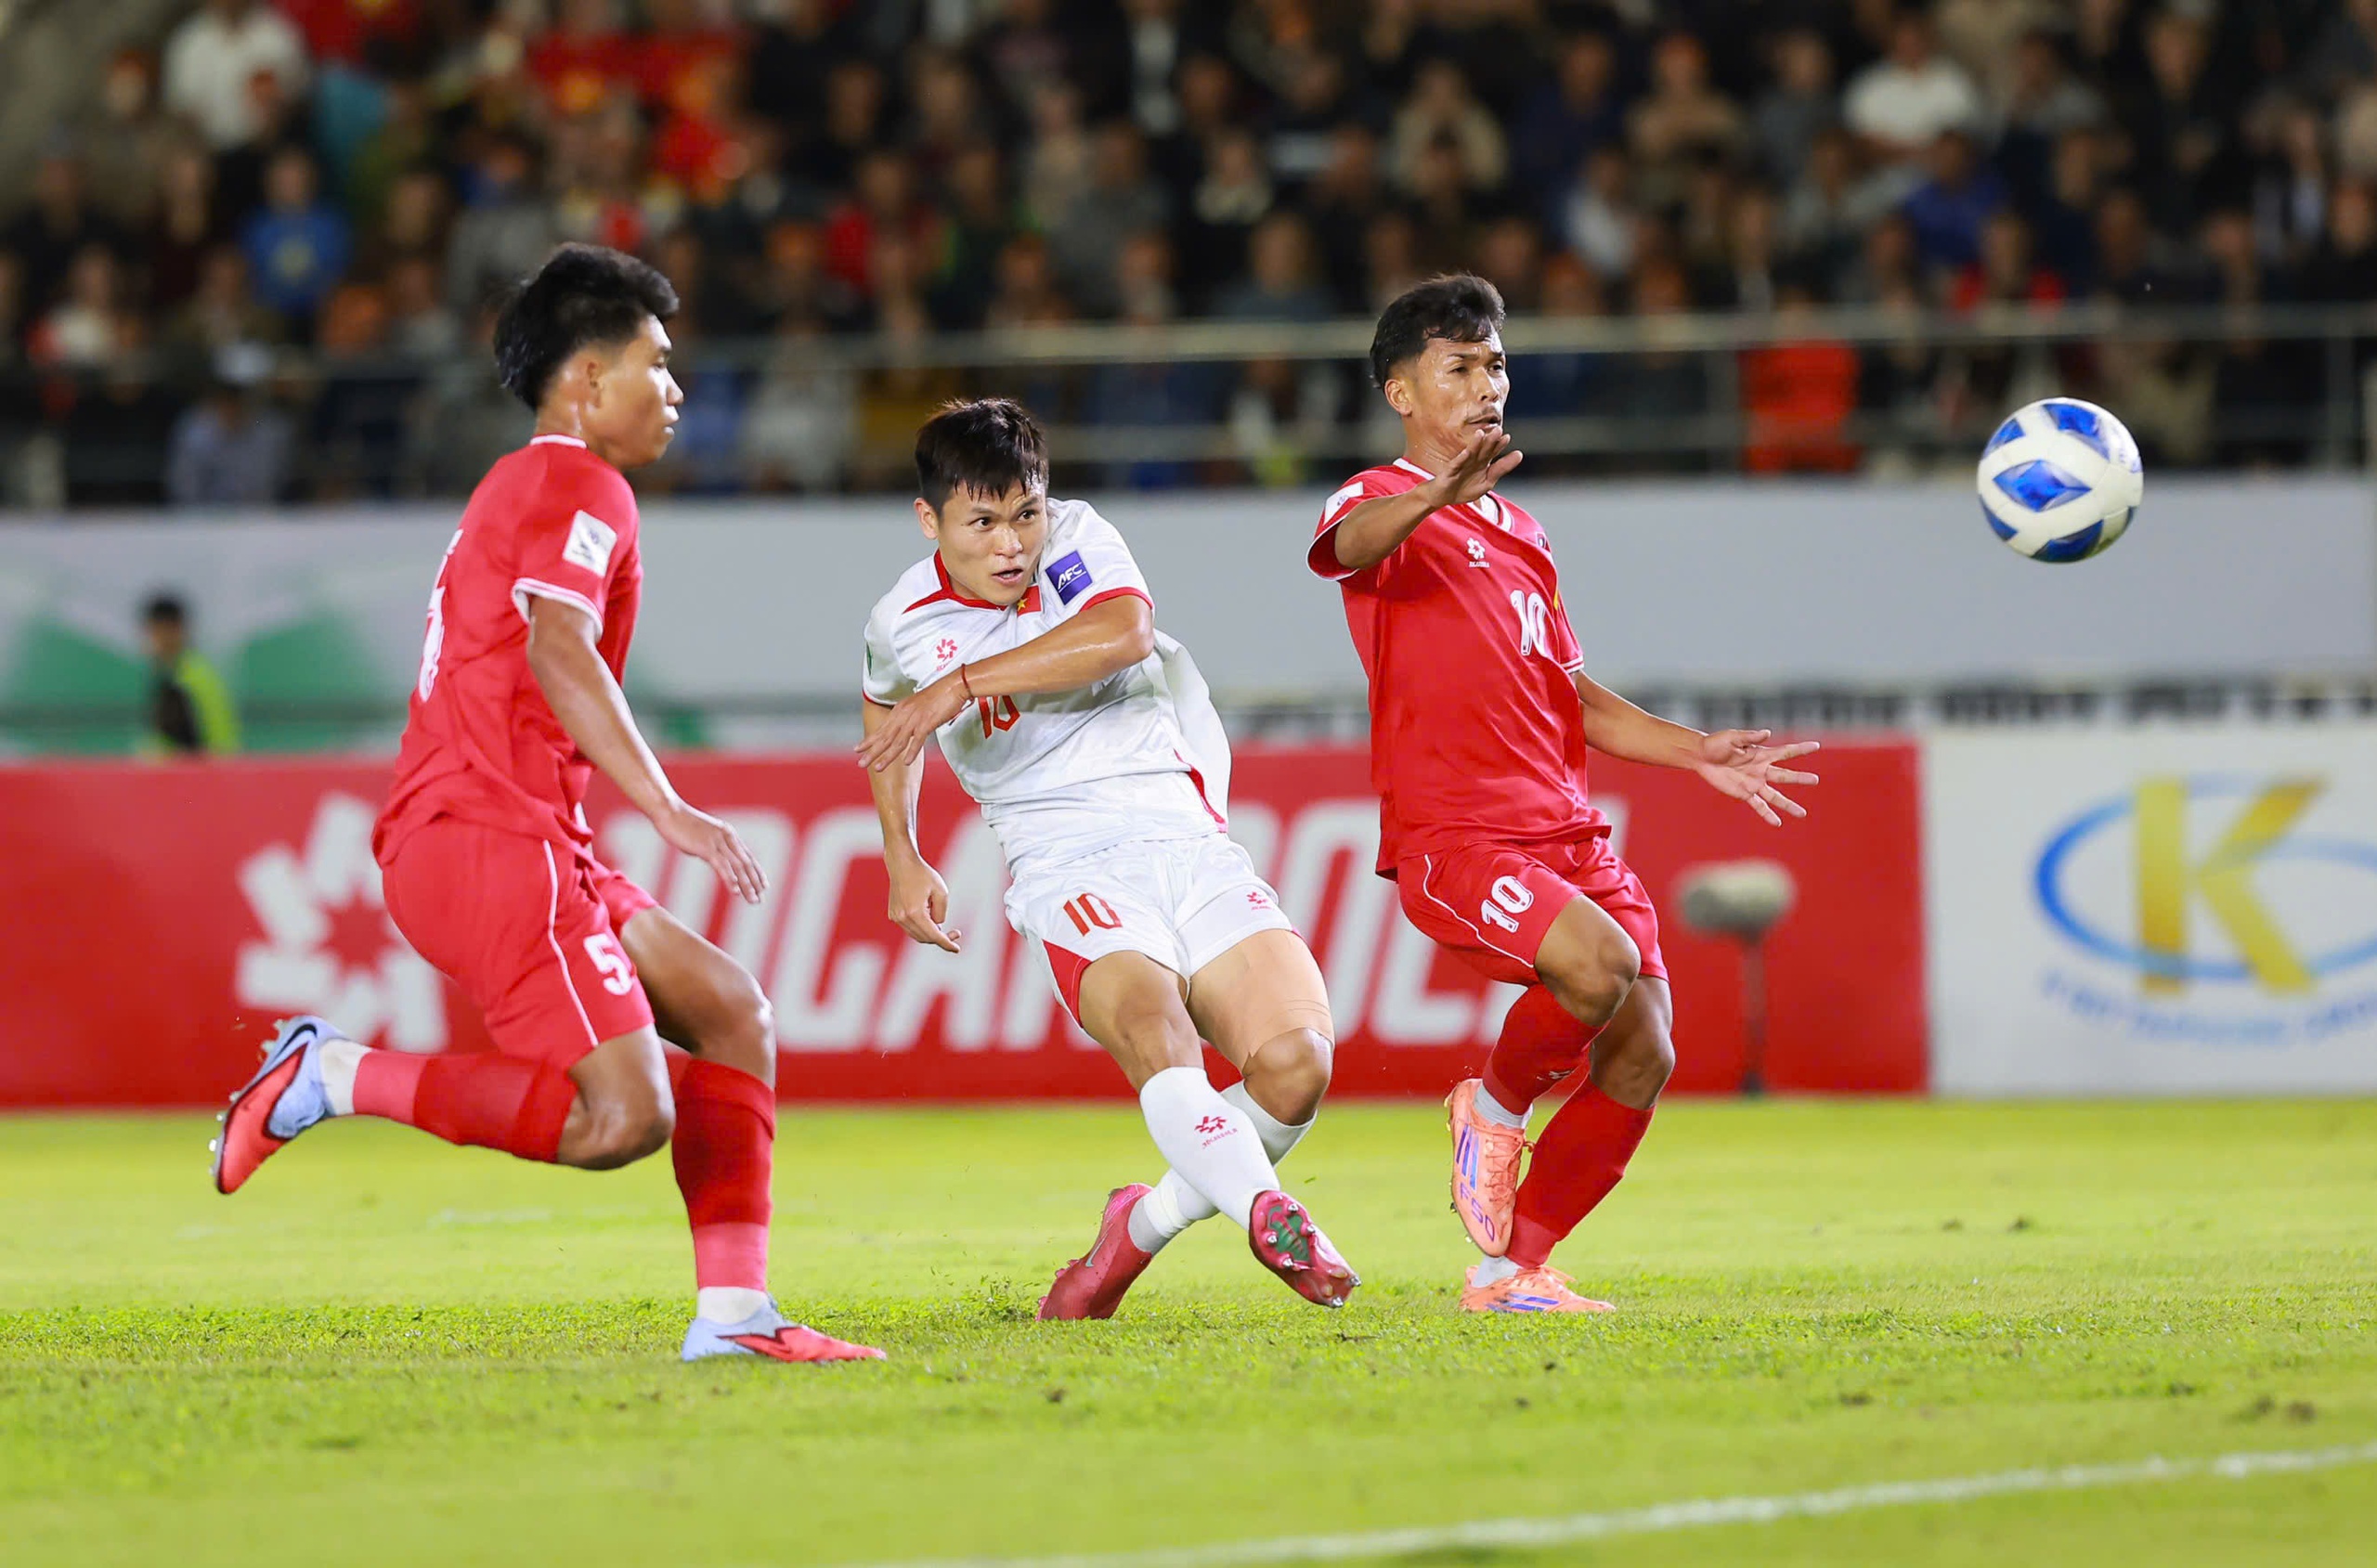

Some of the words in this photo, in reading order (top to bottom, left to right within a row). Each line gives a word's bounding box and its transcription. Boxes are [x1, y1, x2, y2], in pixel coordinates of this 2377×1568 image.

[1058, 562, 1084, 590] AFC
[1510, 590, 1551, 657] 10
[978, 694, 1020, 740] 10
[1481, 875, 1535, 933] 10
[2138, 776, 2327, 994] K
[1063, 893, 1123, 937] 10
[583, 933, 633, 995] 5
[1461, 1182, 1495, 1242] F50
